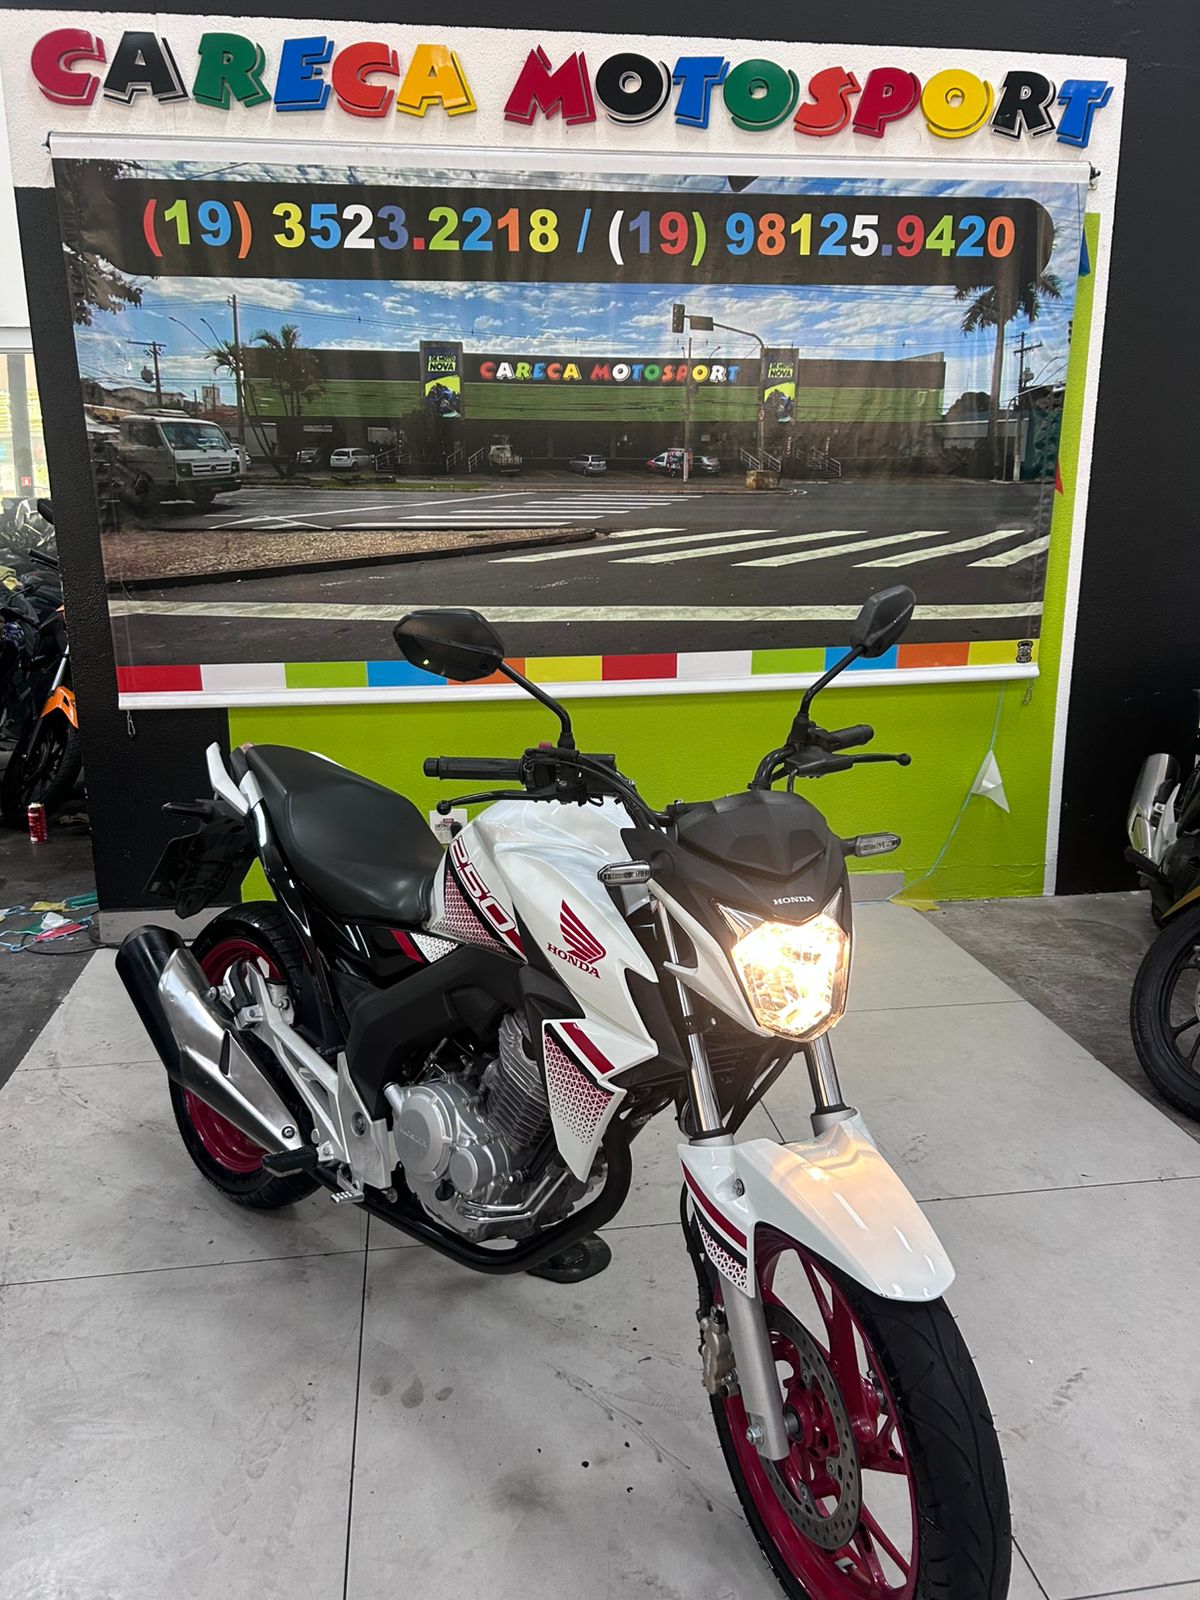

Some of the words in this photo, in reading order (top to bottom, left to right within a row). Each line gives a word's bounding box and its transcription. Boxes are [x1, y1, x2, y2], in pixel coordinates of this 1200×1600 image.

[30, 27, 478, 118] CARECA
[502, 43, 1114, 149] MOTOSPORT
[142, 197, 254, 259] (19)
[272, 202, 560, 254] 3523.2218
[576, 208, 592, 254] /
[608, 209, 706, 266] (19)
[725, 212, 1016, 258] 98125.9420
[430, 362, 454, 371] NOVA
[479, 360, 582, 382] CARECA
[590, 362, 741, 384] MOTOSPORT
[770, 369, 791, 377] NOVA
[450, 835, 516, 933] 250
[773, 895, 815, 905] HONDA
[547, 943, 601, 979] HONDA
